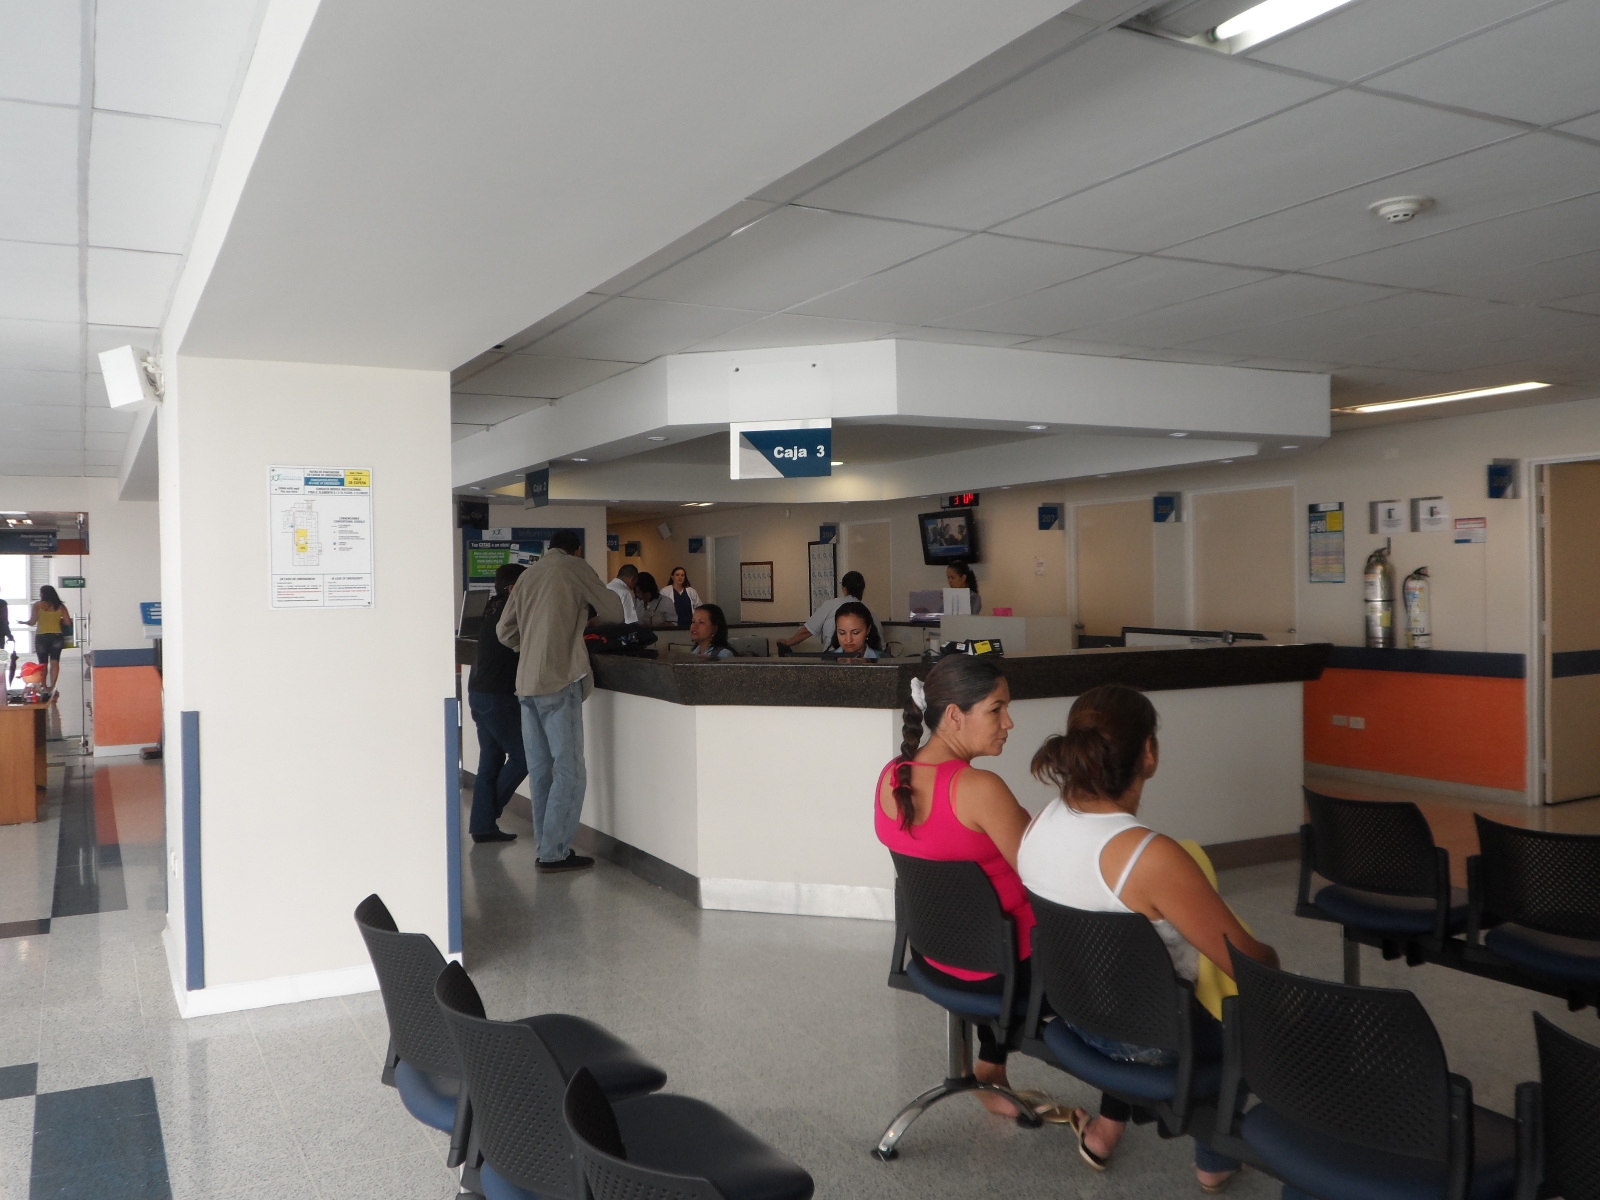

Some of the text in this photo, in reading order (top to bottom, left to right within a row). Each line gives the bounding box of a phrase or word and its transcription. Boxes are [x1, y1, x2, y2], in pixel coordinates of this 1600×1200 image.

[773, 444, 825, 461] Caja 3
[543, 481, 547, 491] 2
